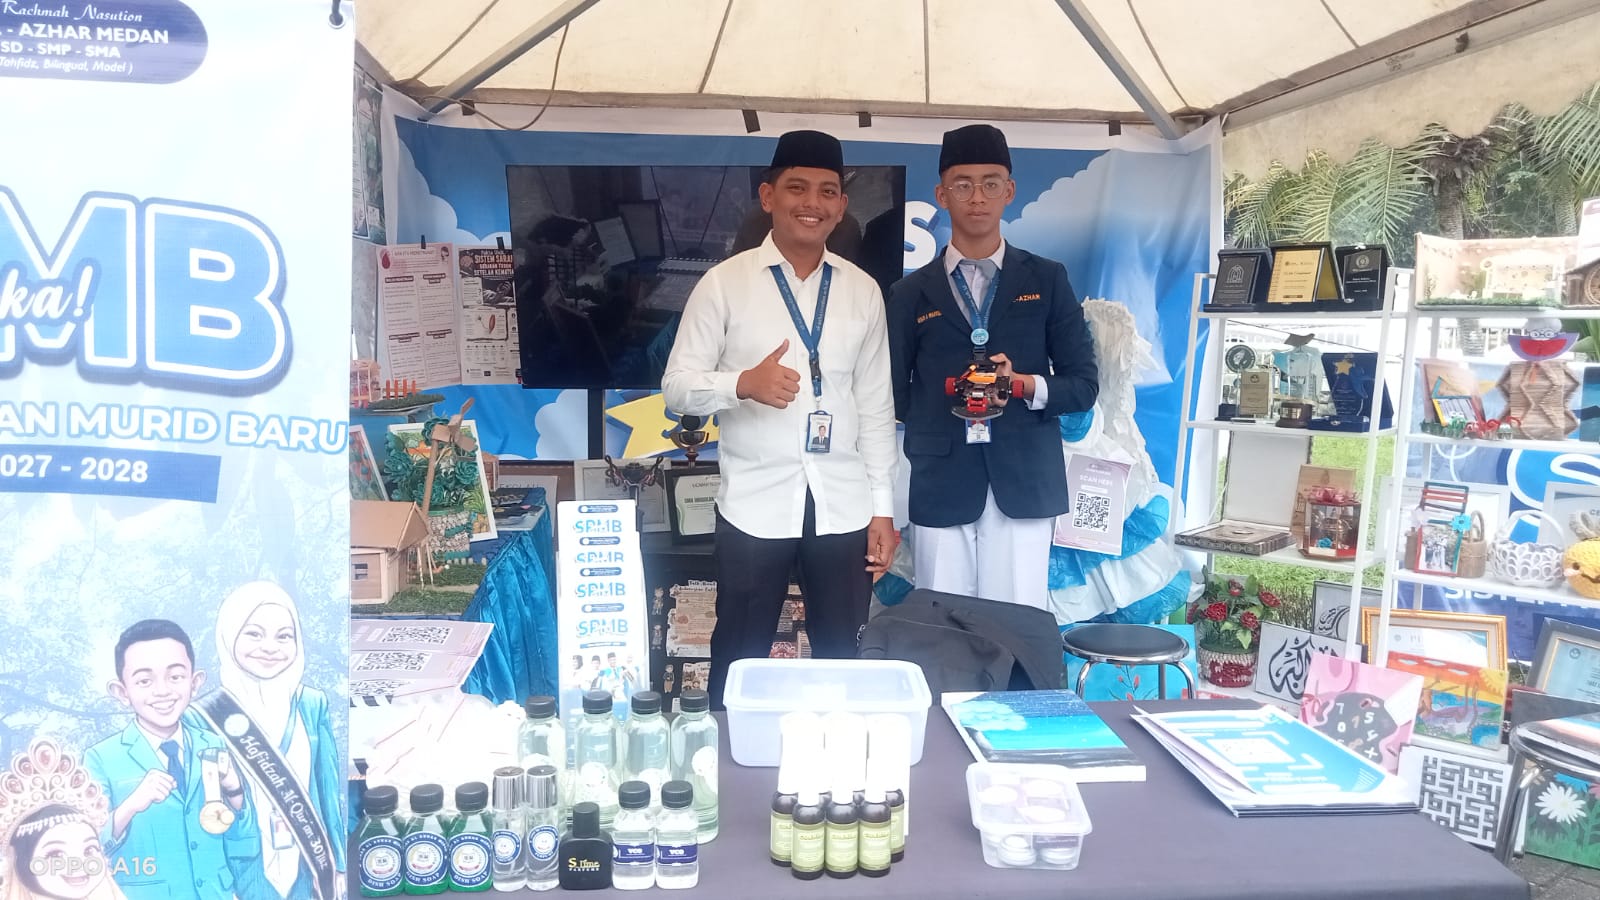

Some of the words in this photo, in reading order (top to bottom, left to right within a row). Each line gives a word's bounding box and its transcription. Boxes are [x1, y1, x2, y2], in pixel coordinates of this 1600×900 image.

[2, 0, 69, 18] Rachmah
[73, 4, 143, 22] Nasution
[18, 22, 92, 41] AZHAR
[96, 26, 169, 44] MEDAN
[0, 41, 23, 54] SD
[37, 43, 72, 56] SMP
[85, 46, 121, 59] SMA
[92, 61, 126, 72] Model
[70, 405, 218, 441] MURID
[228, 417, 347, 452] BARU
[80, 457, 149, 484] 2028
[240, 735, 287, 789] Hafidzah
